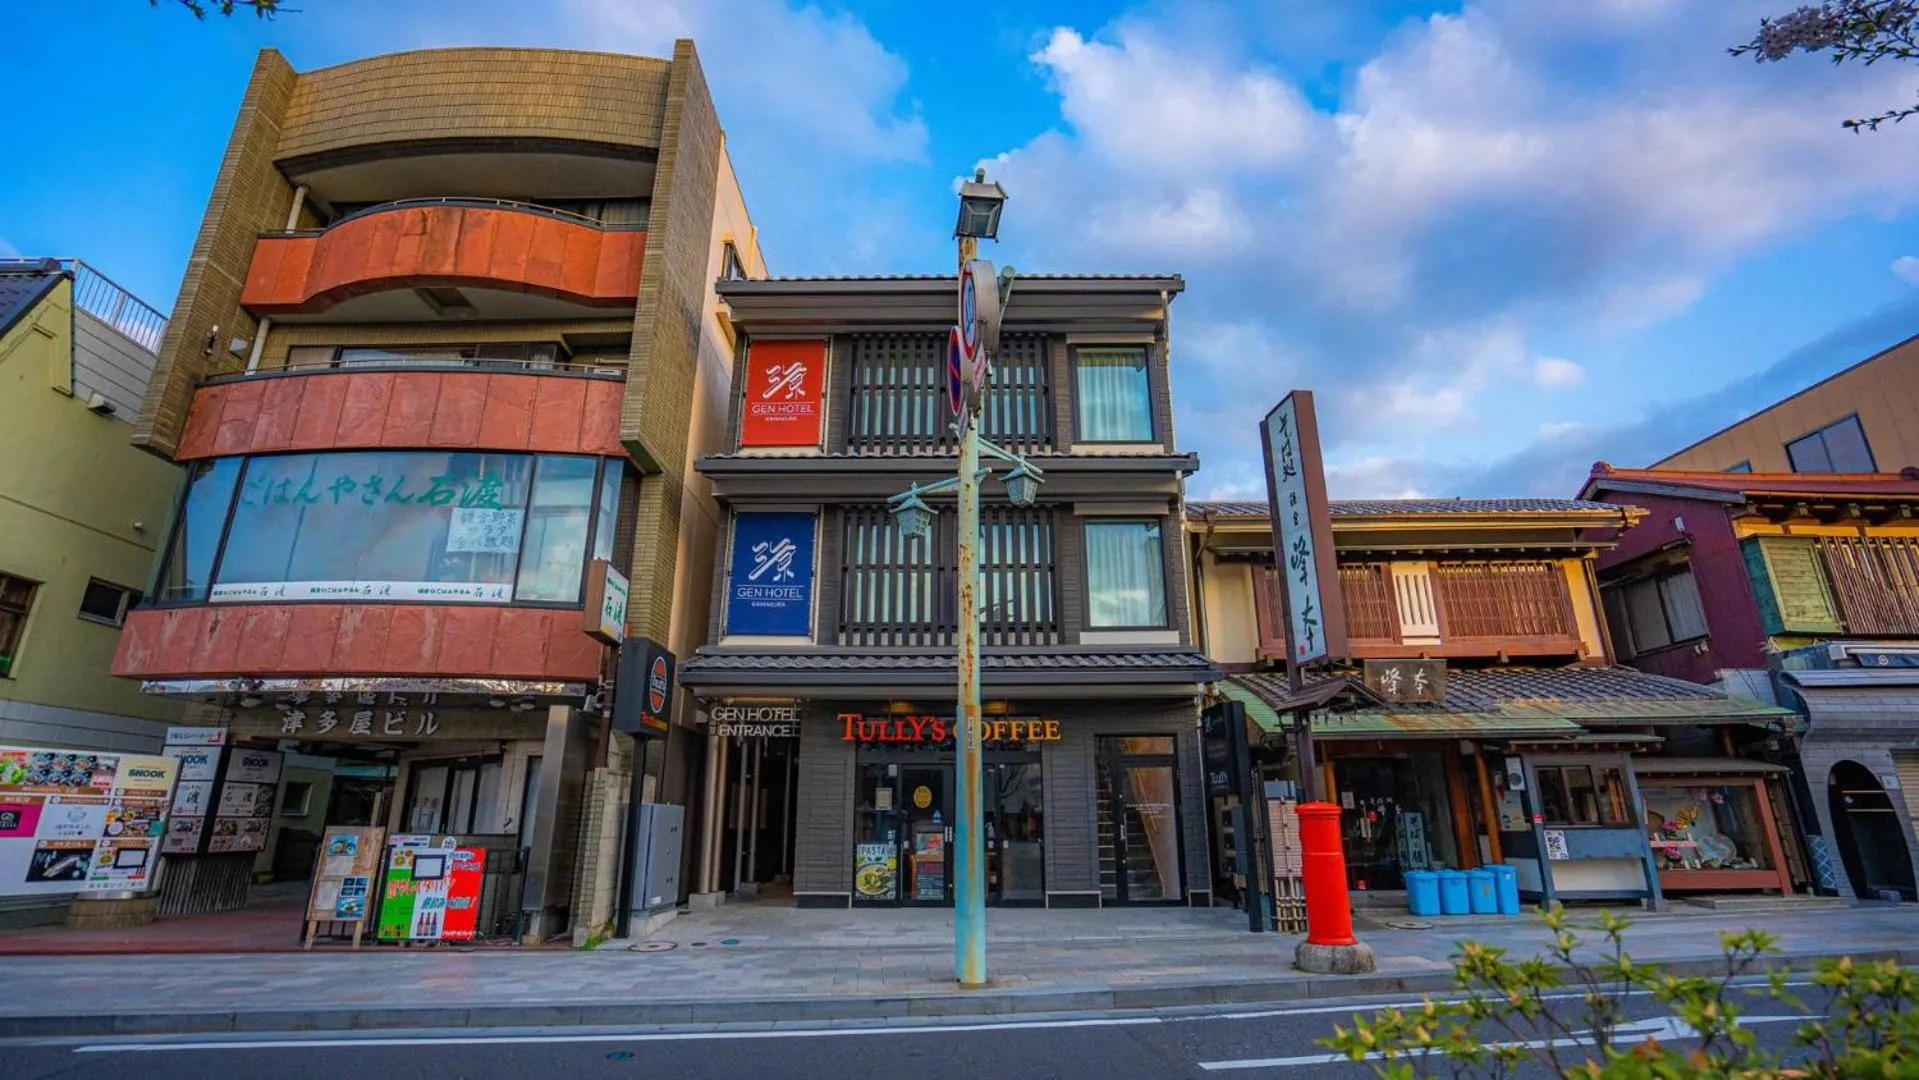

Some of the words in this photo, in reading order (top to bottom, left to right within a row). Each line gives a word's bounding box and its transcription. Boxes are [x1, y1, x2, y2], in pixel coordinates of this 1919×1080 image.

[752, 404, 776, 413] GEN
[779, 404, 812, 413] HOTEL
[737, 587, 762, 597] GEN
[765, 588, 803, 598] HOTEL
[711, 707, 745, 721] GEN
[747, 707, 800, 721] HOTEL
[281, 709, 439, 735] 津多屋ビル
[719, 724, 791, 737] ENTRANCE
[127, 768, 166, 779] SNOOK
